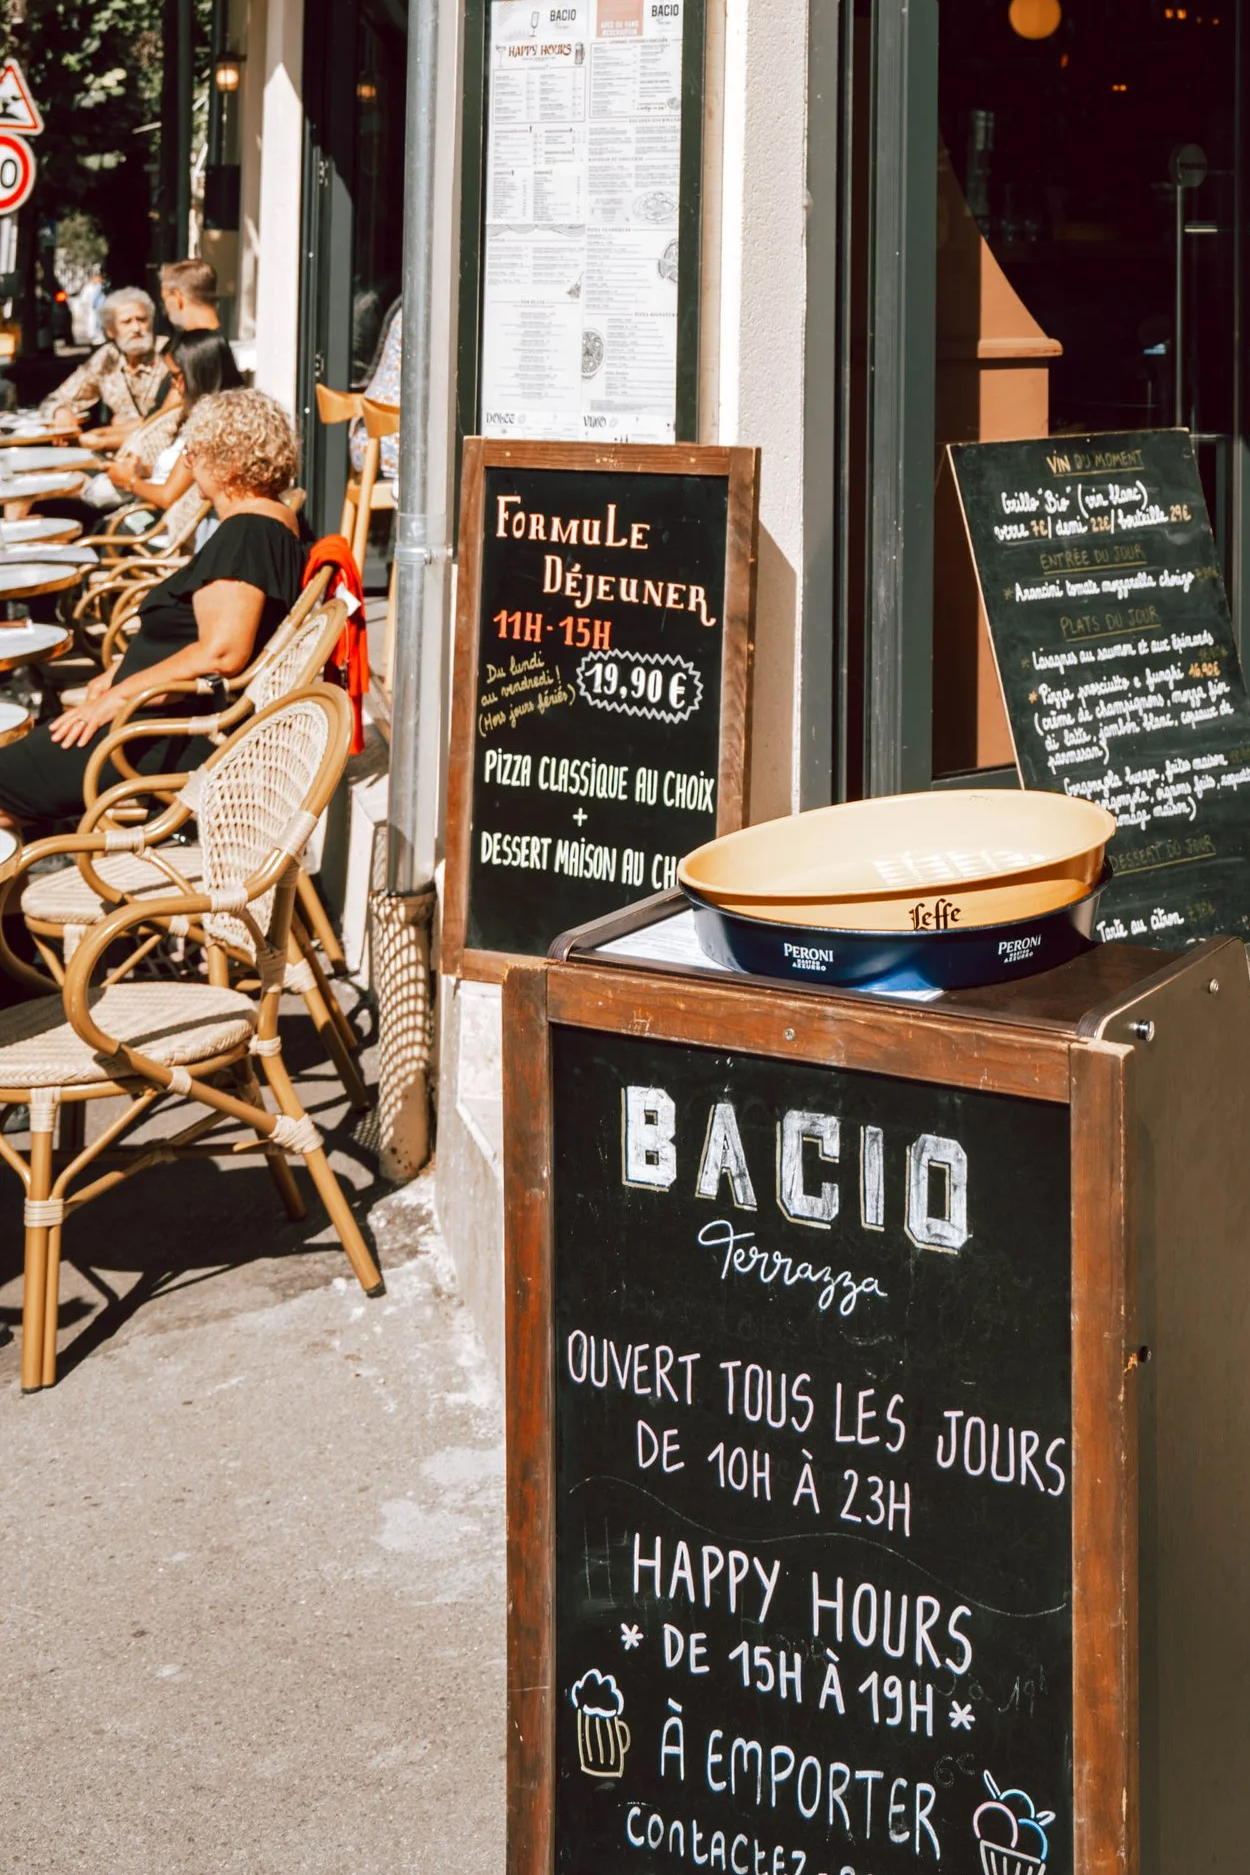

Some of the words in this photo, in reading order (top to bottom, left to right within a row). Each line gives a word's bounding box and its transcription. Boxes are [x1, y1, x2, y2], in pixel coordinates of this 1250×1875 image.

[550, 8, 577, 22] BACIO
[651, 4, 679, 17] BACIO
[508, 44, 540, 57] HAPPY
[541, 43, 572, 57] HOURS
[1095, 449, 1145, 468] MOMENT
[994, 524, 1030, 541] verre
[1055, 515, 1088, 536] demi
[1117, 504, 1169, 530] bouteille
[1040, 547, 1090, 570] ENTRÉE
[1094, 548, 1110, 563] DU
[1113, 543, 1147, 561] JOUR
[542, 555, 717, 628] DÉJEUNER
[1015, 579, 1064, 602] Arancini
[1065, 578, 1100, 597] tomate
[1101, 572, 1157, 600] mozzarella
[1159, 569, 1195, 593] chorizo
[1060, 615, 1101, 638] PLATS
[1105, 612, 1124, 630] DU
[1127, 605, 1161, 626] JOUR
[486, 663, 507, 684] Du
[510, 650, 545, 676] lundi
[1032, 648, 1078, 675] Lasagnes
[1079, 649, 1095, 664] au
[1097, 643, 1137, 661] saumon
[1138, 639, 1150, 655] et
[1151, 638, 1171, 654] aux
[481, 692, 498, 706] au
[585, 662, 664, 704] 19,90
[669, 671, 688, 709] €
[1038, 682, 1075, 709] Pizza
[1077, 674, 1130, 707] prosciutto
[1133, 677, 1142, 688] e
[1145, 662, 1184, 691] funghi
[1077, 707, 1093, 723] de
[1172, 685, 1207, 707] mozza
[1208, 679, 1231, 702] fior
[478, 712, 507, 738] (Hors
[509, 701, 535, 729] jours
[537, 684, 577, 715] fériés)
[1045, 735, 1059, 752] di
[1099, 717, 1140, 745] jambon
[1180, 705, 1218, 730] copeaux
[1219, 699, 1234, 717] de
[1048, 742, 1110, 775] parmesan)
[1192, 753, 1229, 770] maison
[635, 766, 659, 806] AU
[1156, 781, 1192, 807] oignons
[480, 831, 552, 871] DESSERT
[621, 848, 645, 887] AU
[652, 853, 680, 890] CH
[908, 897, 963, 931] Leffe
[1096, 919, 1129, 943] Tarte
[1131, 918, 1147, 935] au
[1150, 906, 1184, 929] citron
[783, 942, 834, 963] PERONI
[997, 934, 1042, 956] PERONI
[620, 1085, 973, 1255] BACIO
[697, 1219, 888, 1316] Terrazza
[567, 1328, 700, 1406] OUVERT
[719, 1360, 815, 1433] TOUS
[835, 1381, 907, 1453] LES
[936, 1409, 1067, 1497] JOURS
[637, 1419, 686, 1474] DE
[707, 1442, 772, 1501] 10H
[793, 1448, 821, 1514] À
[840, 1468, 912, 1537] 23H
[632, 1532, 782, 1624] HAPPY
[811, 1570, 973, 1676] HOURS
[663, 1622, 710, 1674] DE
[728, 1640, 802, 1704] 15H
[819, 1648, 846, 1716] À
[857, 1670, 934, 1737] 19H
[661, 1698, 686, 1781] À
[706, 1728, 942, 1862] EMPORTER
